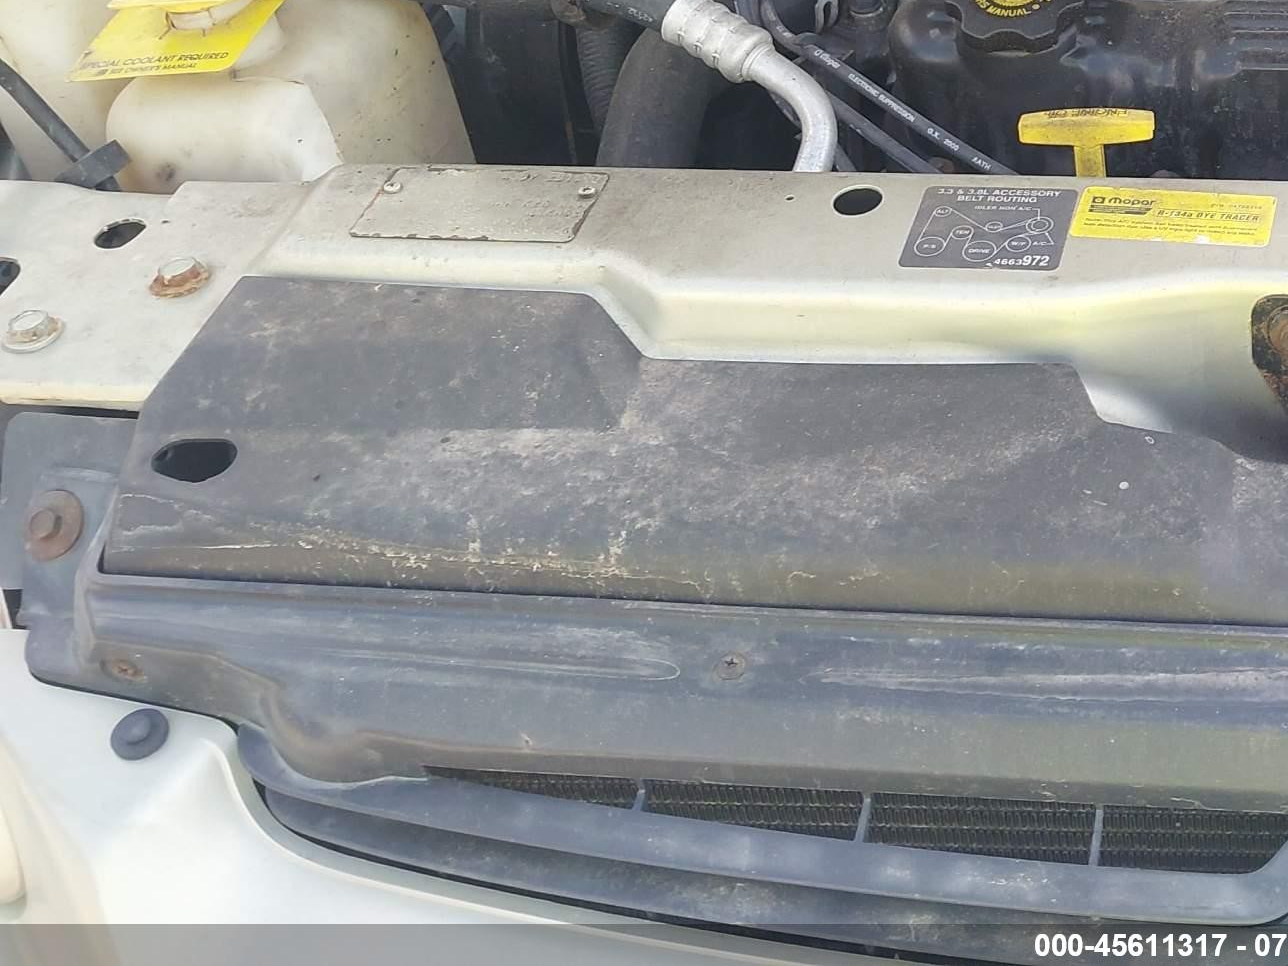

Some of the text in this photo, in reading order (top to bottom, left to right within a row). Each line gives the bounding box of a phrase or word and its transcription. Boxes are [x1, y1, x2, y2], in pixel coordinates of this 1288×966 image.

[986, 5, 1032, 17] MANUAL
[122, 55, 176, 66] COOLANT
[177, 51, 229, 61] REQUIRED
[1108, 196, 1157, 206] Mopar
[1220, 213, 1260, 222] TRACER
[994, 255, 1050, 267] 4663972
